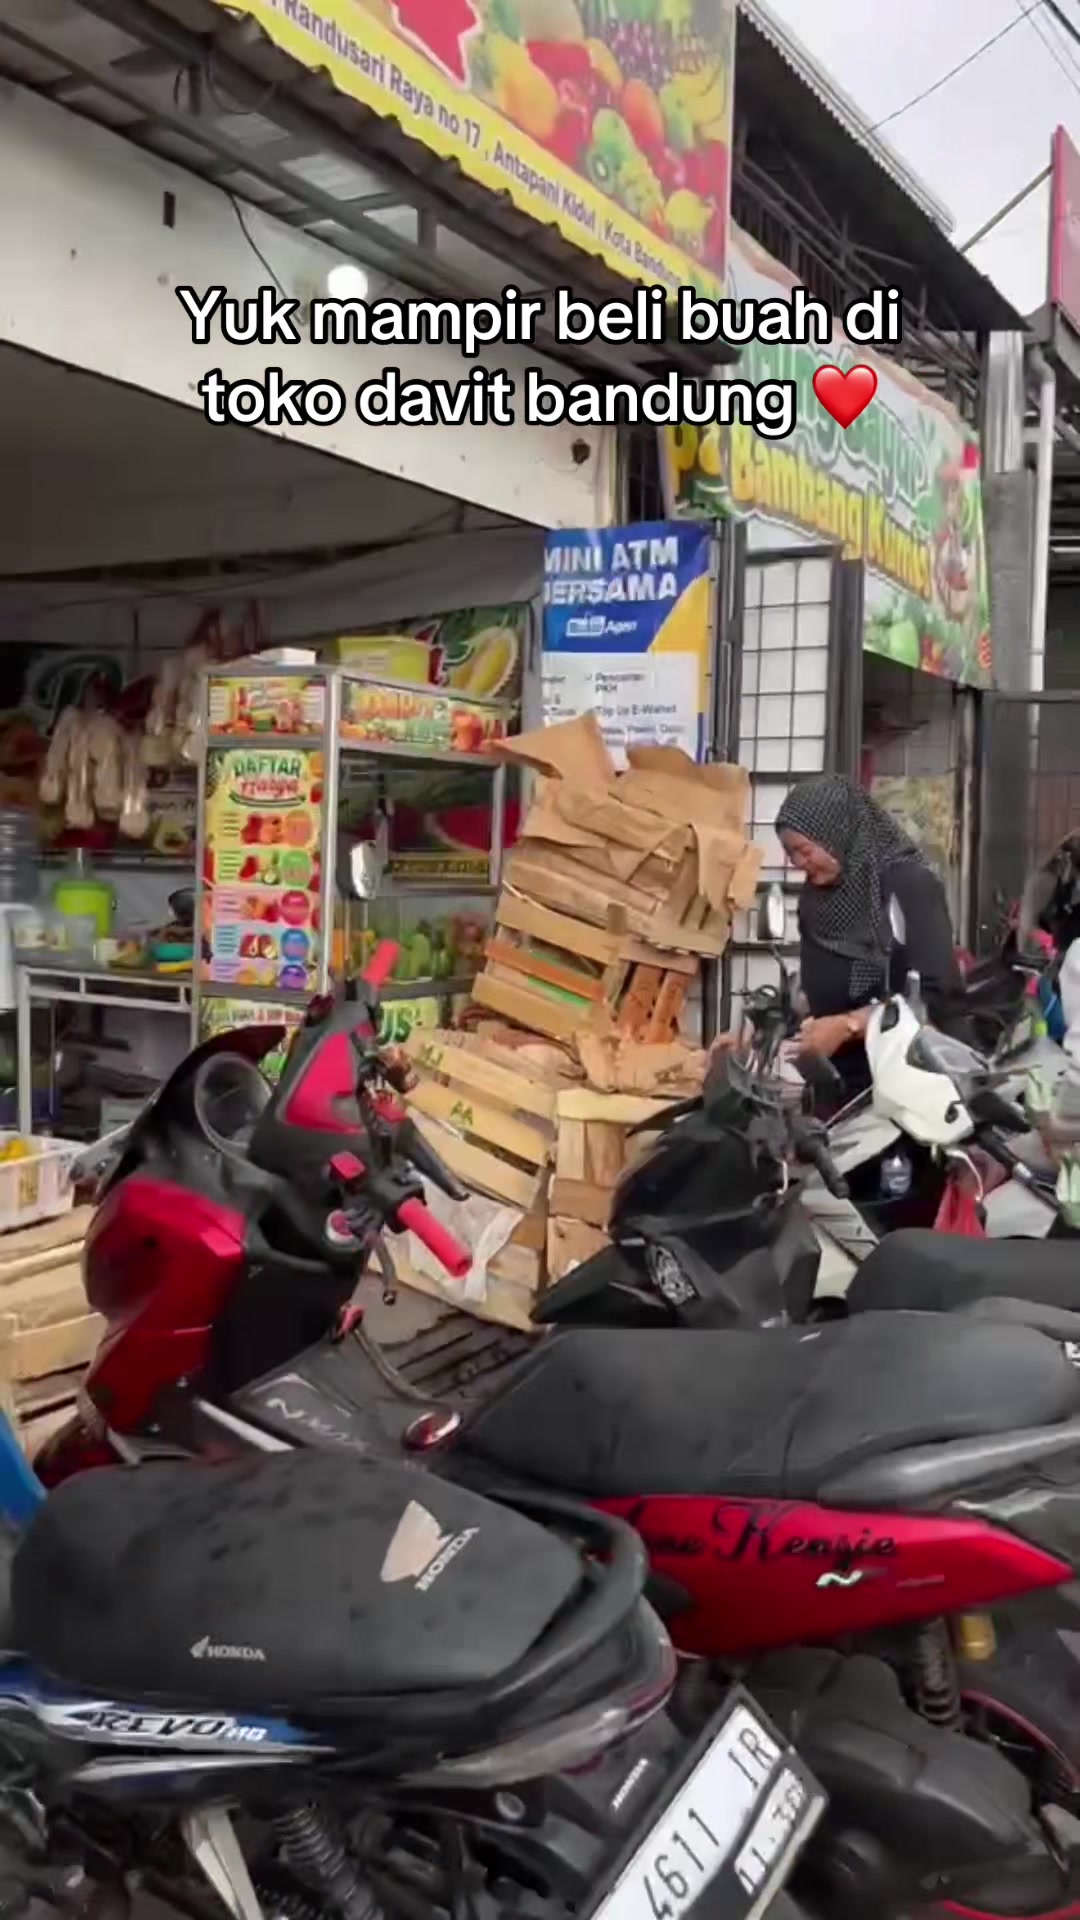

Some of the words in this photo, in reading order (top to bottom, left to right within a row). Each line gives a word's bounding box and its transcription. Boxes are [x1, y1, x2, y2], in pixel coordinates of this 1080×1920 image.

[285, 0, 385, 84] Randusari
[390, 65, 434, 116] Raya
[439, 105, 459, 135] no
[494, 140, 560, 208] Antapani
[604, 217, 632, 257] Kota
[611, 536, 679, 572] ATM
[730, 412, 864, 561] Bambang
[866, 483, 932, 603] Kumis
[233, 755, 301, 778] DAFTAR
[207, 1645, 267, 1661] HONDA
[642, 1807, 720, 1920] 4611
[727, 1727, 774, 1790] IR
